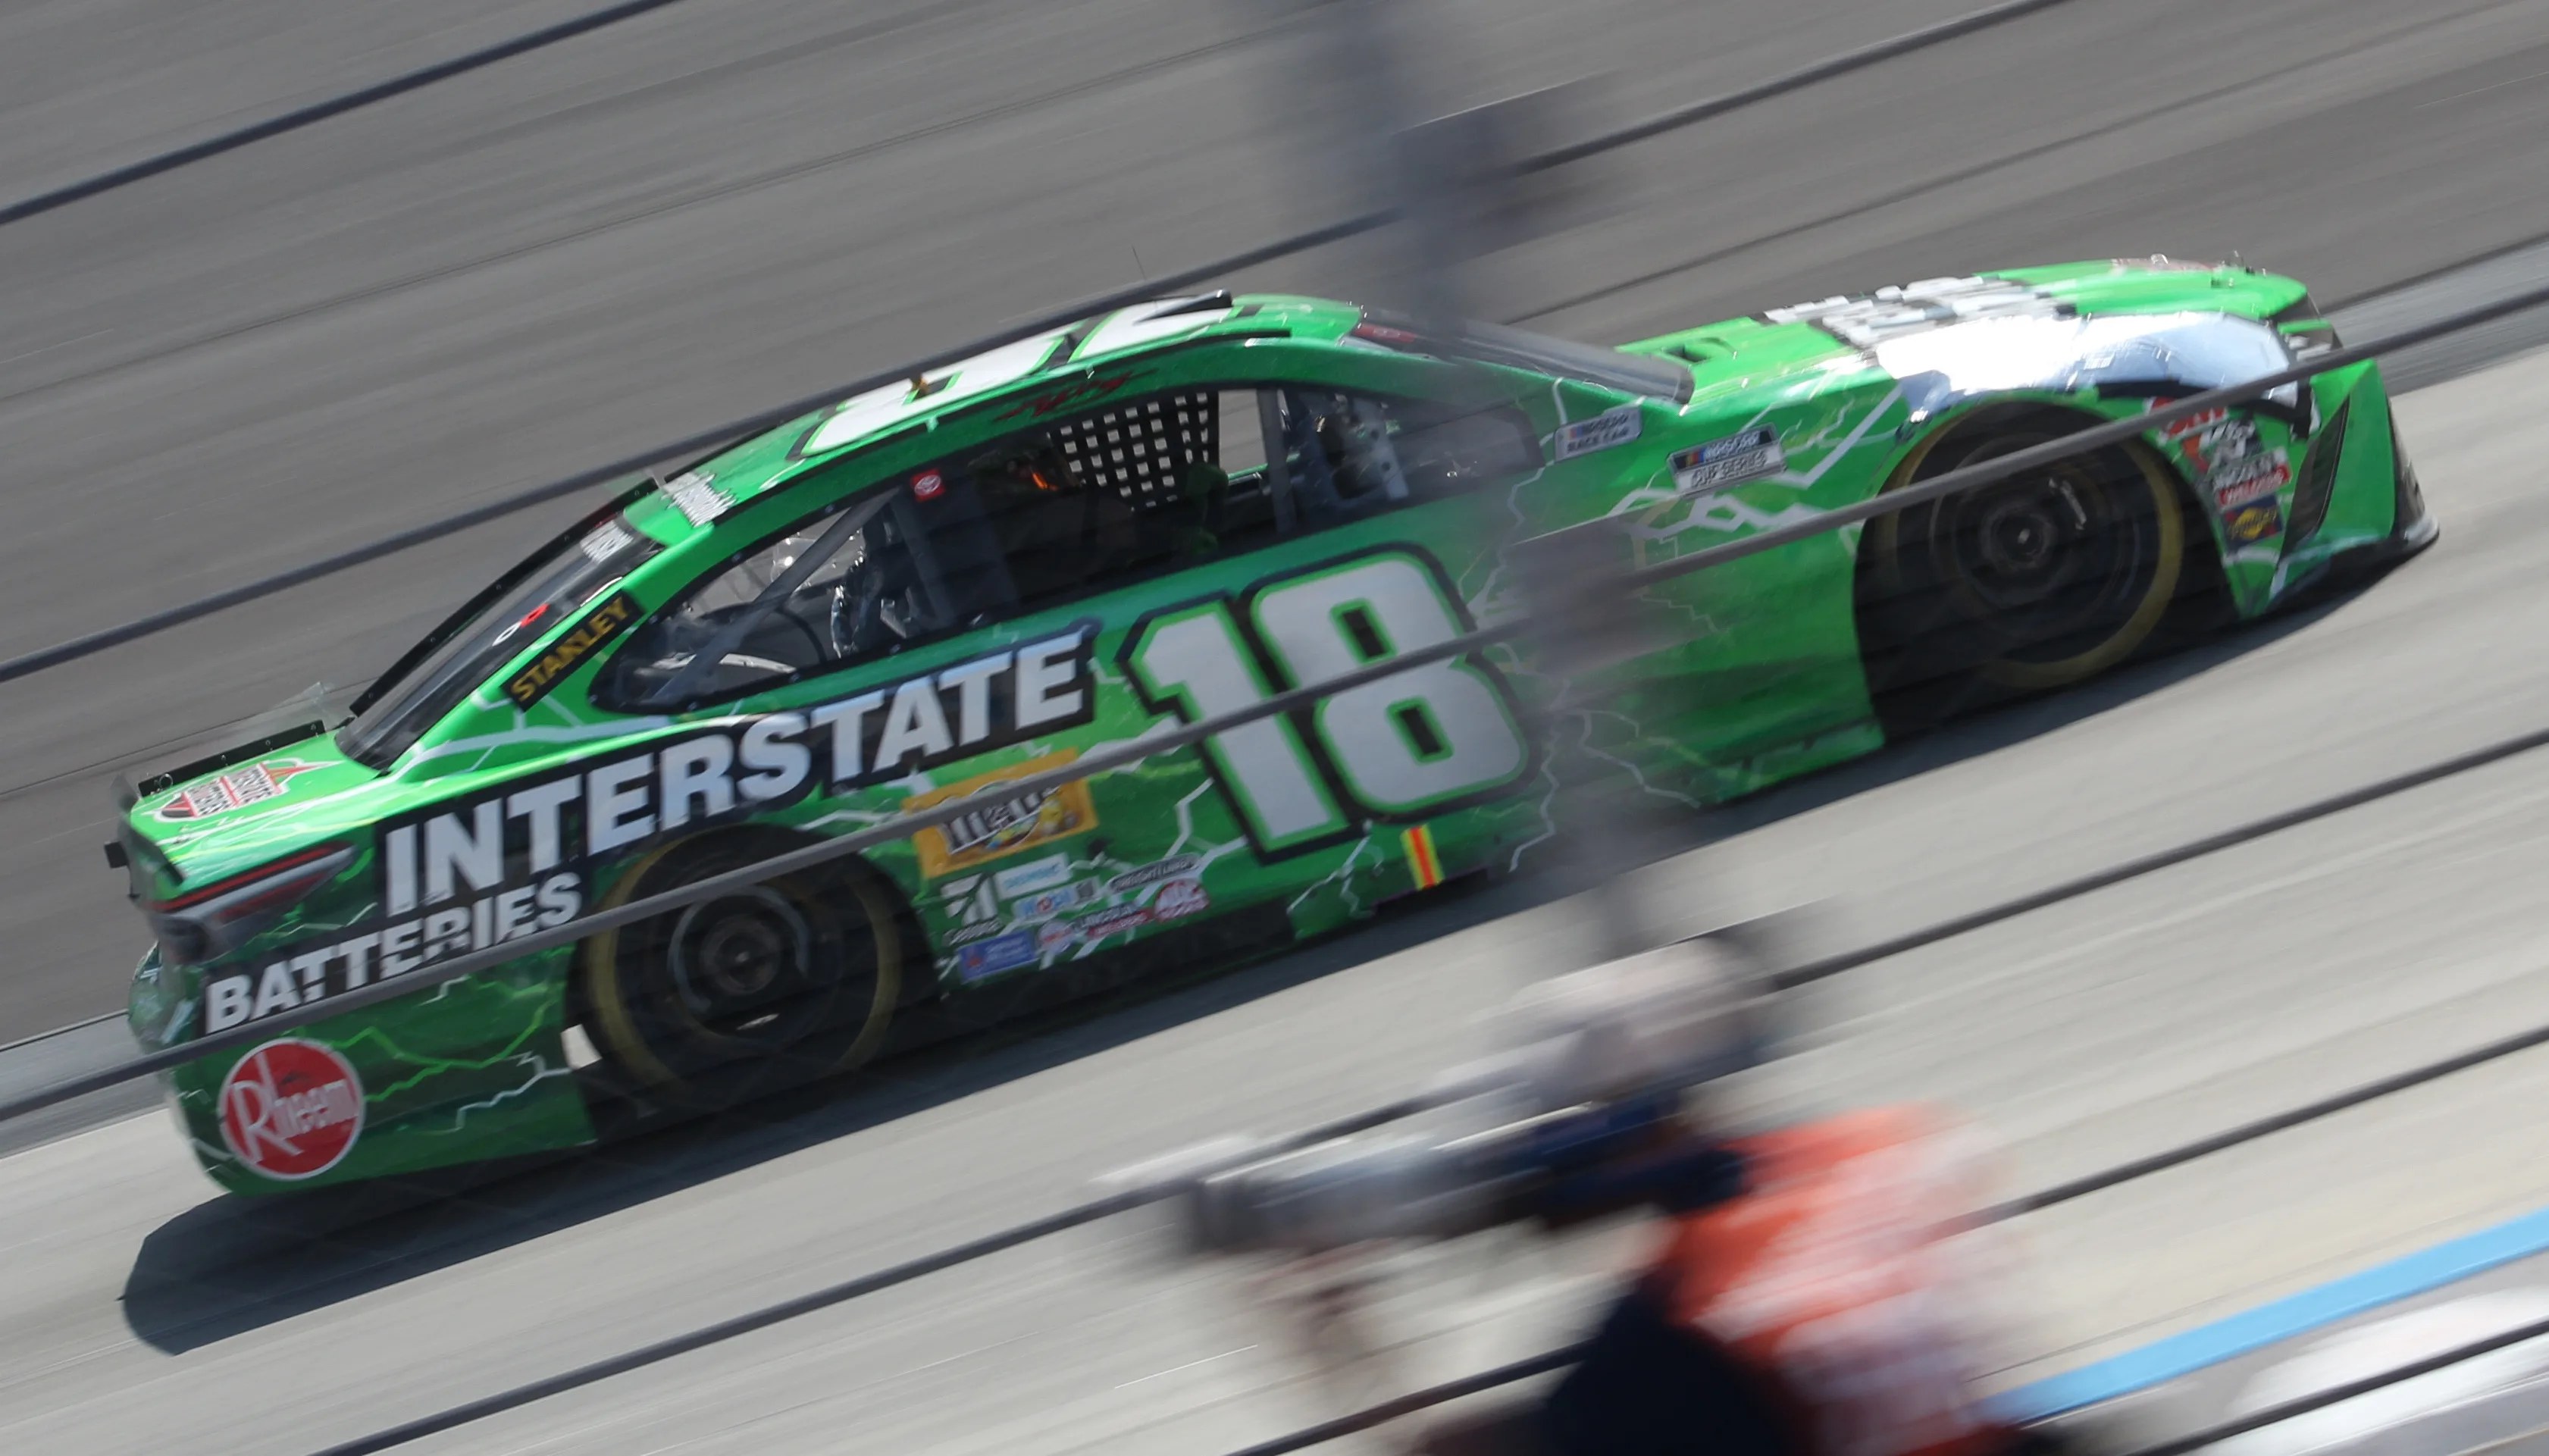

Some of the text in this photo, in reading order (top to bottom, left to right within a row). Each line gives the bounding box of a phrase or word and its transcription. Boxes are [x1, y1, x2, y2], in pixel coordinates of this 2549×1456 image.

[511, 596, 628, 702] STANLEY
[1126, 550, 1531, 852] 18
[384, 631, 1085, 918] INTERSTATE
[205, 872, 582, 1034] BATTERIES
[228, 1050, 359, 1164] Rheem
